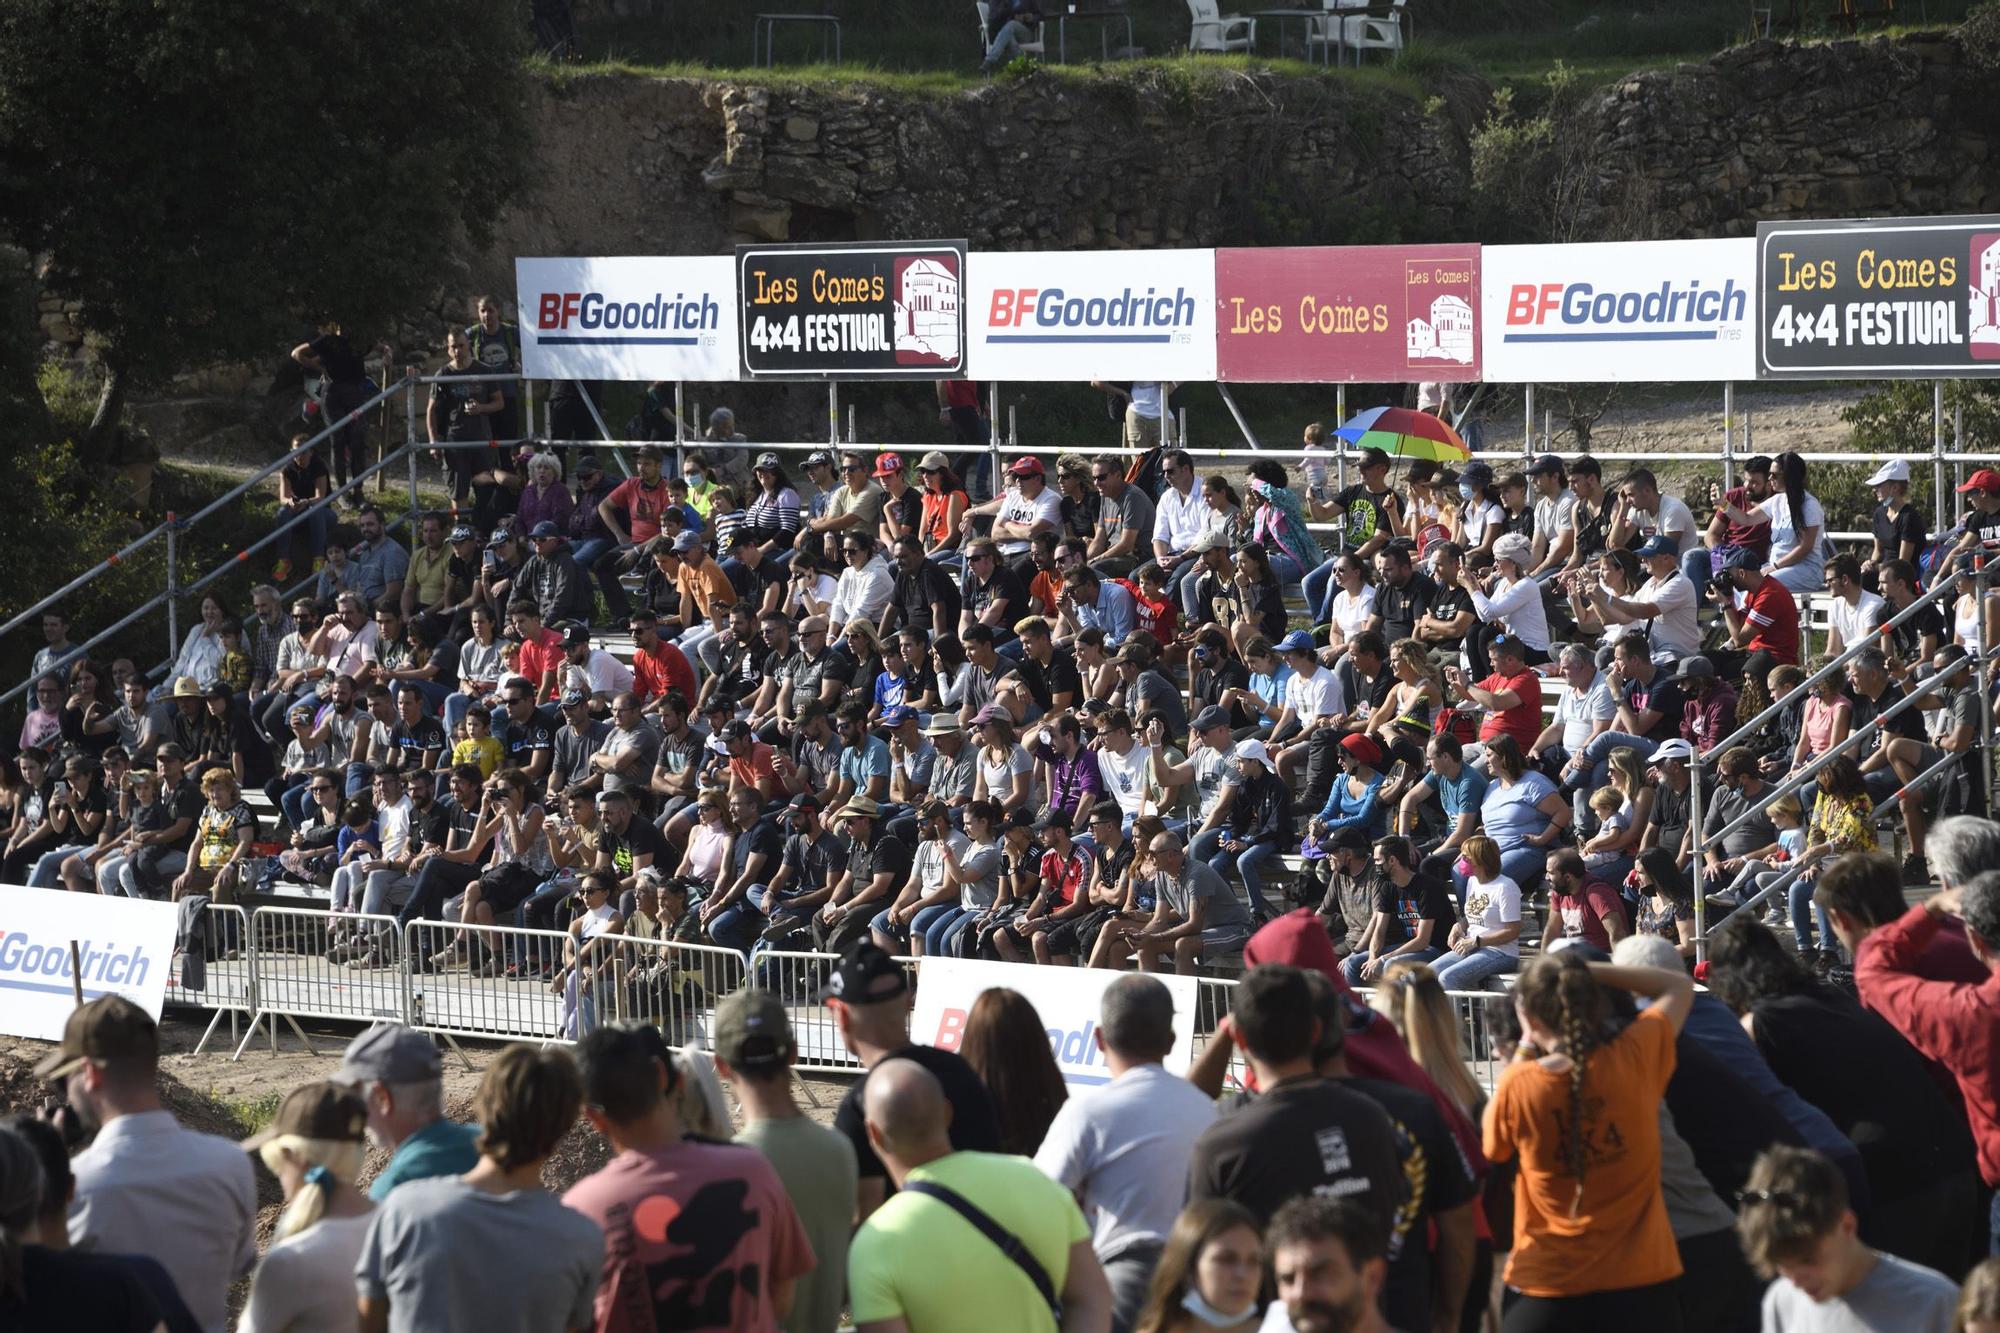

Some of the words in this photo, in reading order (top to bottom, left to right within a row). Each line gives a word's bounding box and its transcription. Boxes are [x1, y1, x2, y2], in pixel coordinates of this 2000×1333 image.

[754, 271, 799, 305] Les
[812, 269, 885, 304] Comes
[1407, 269, 1429, 285] Les
[1435, 268, 1470, 285] Comes
[1780, 252, 1837, 291] Les
[1856, 249, 1956, 289] Comes
[538, 292, 718, 330] BFGoodrich
[988, 287, 1195, 327] BFGoodrich
[1231, 297, 1282, 334] Les
[1299, 296, 1389, 334] Comes
[1506, 279, 1746, 326] BFGoodrich
[698, 333, 717, 347] Tires
[750, 315, 801, 352] 4x4
[805, 312, 891, 352] FESTIVAL
[1172, 330, 1192, 345] Tires
[1717, 325, 1742, 341] Tires
[1771, 303, 1839, 347] 4x4
[1845, 300, 1964, 346] FESTIVAL
